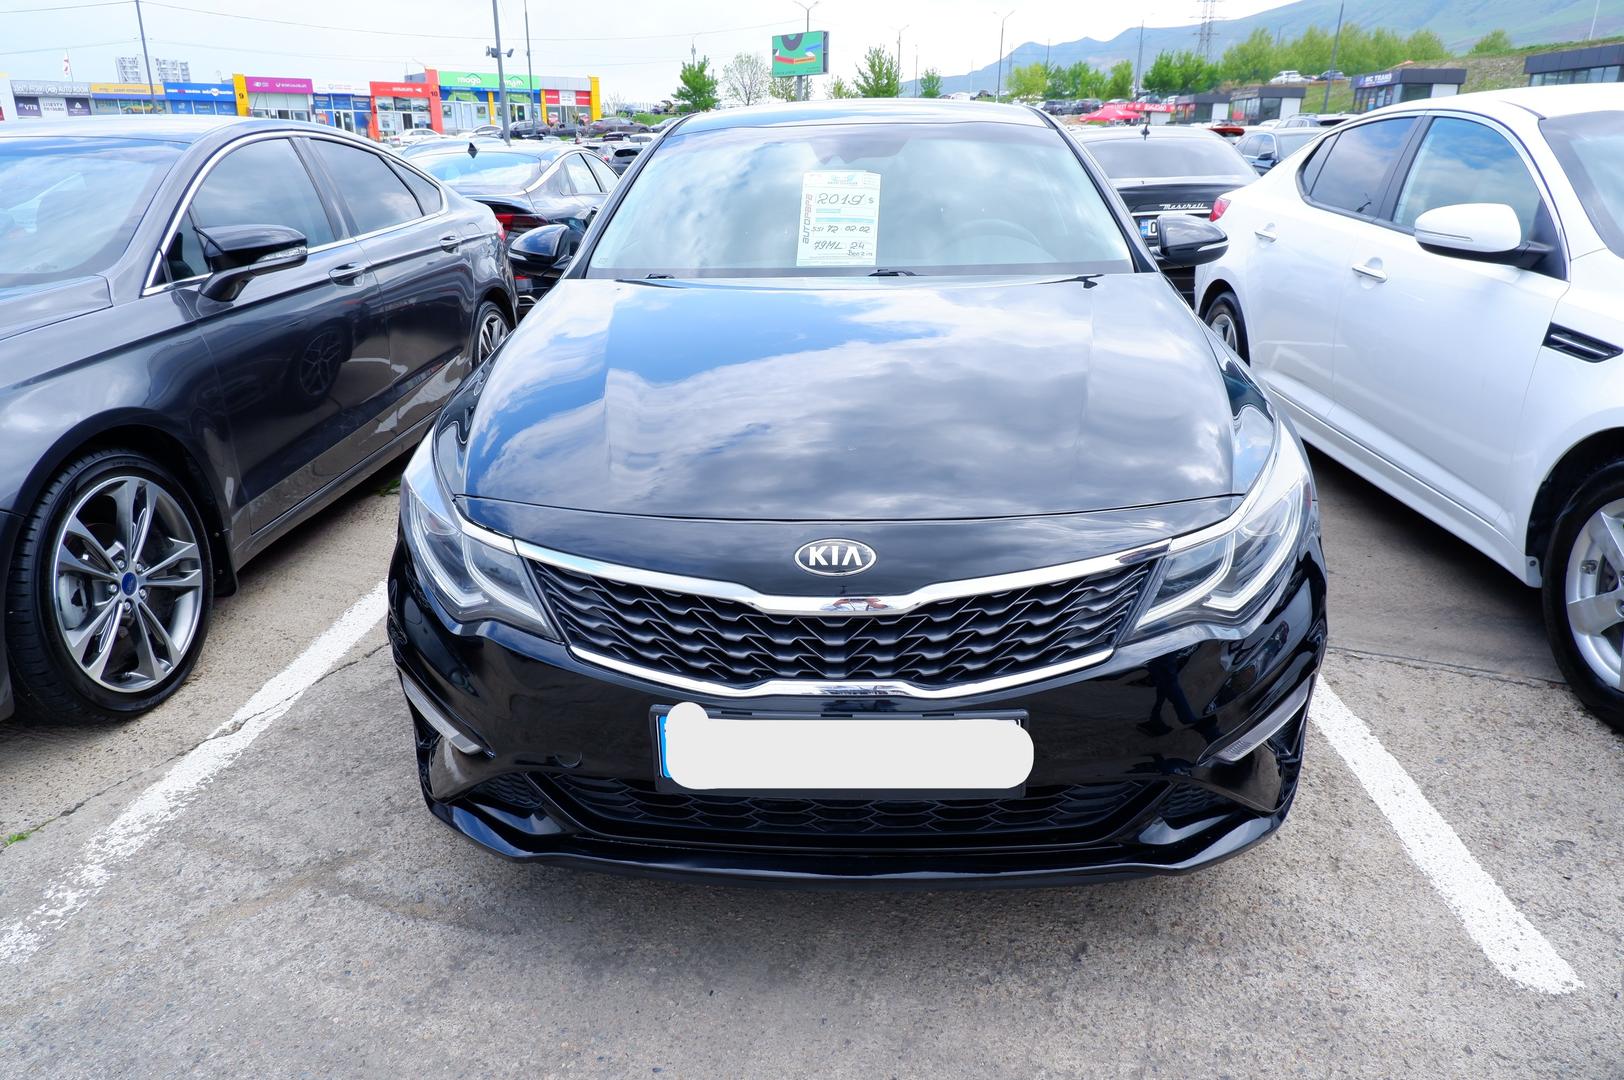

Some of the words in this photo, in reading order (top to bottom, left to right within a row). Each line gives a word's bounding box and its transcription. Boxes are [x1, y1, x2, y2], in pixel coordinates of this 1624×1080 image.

[456, 76, 482, 86] mogo
[817, 192, 865, 206] 2019
[808, 545, 863, 566] KIA
